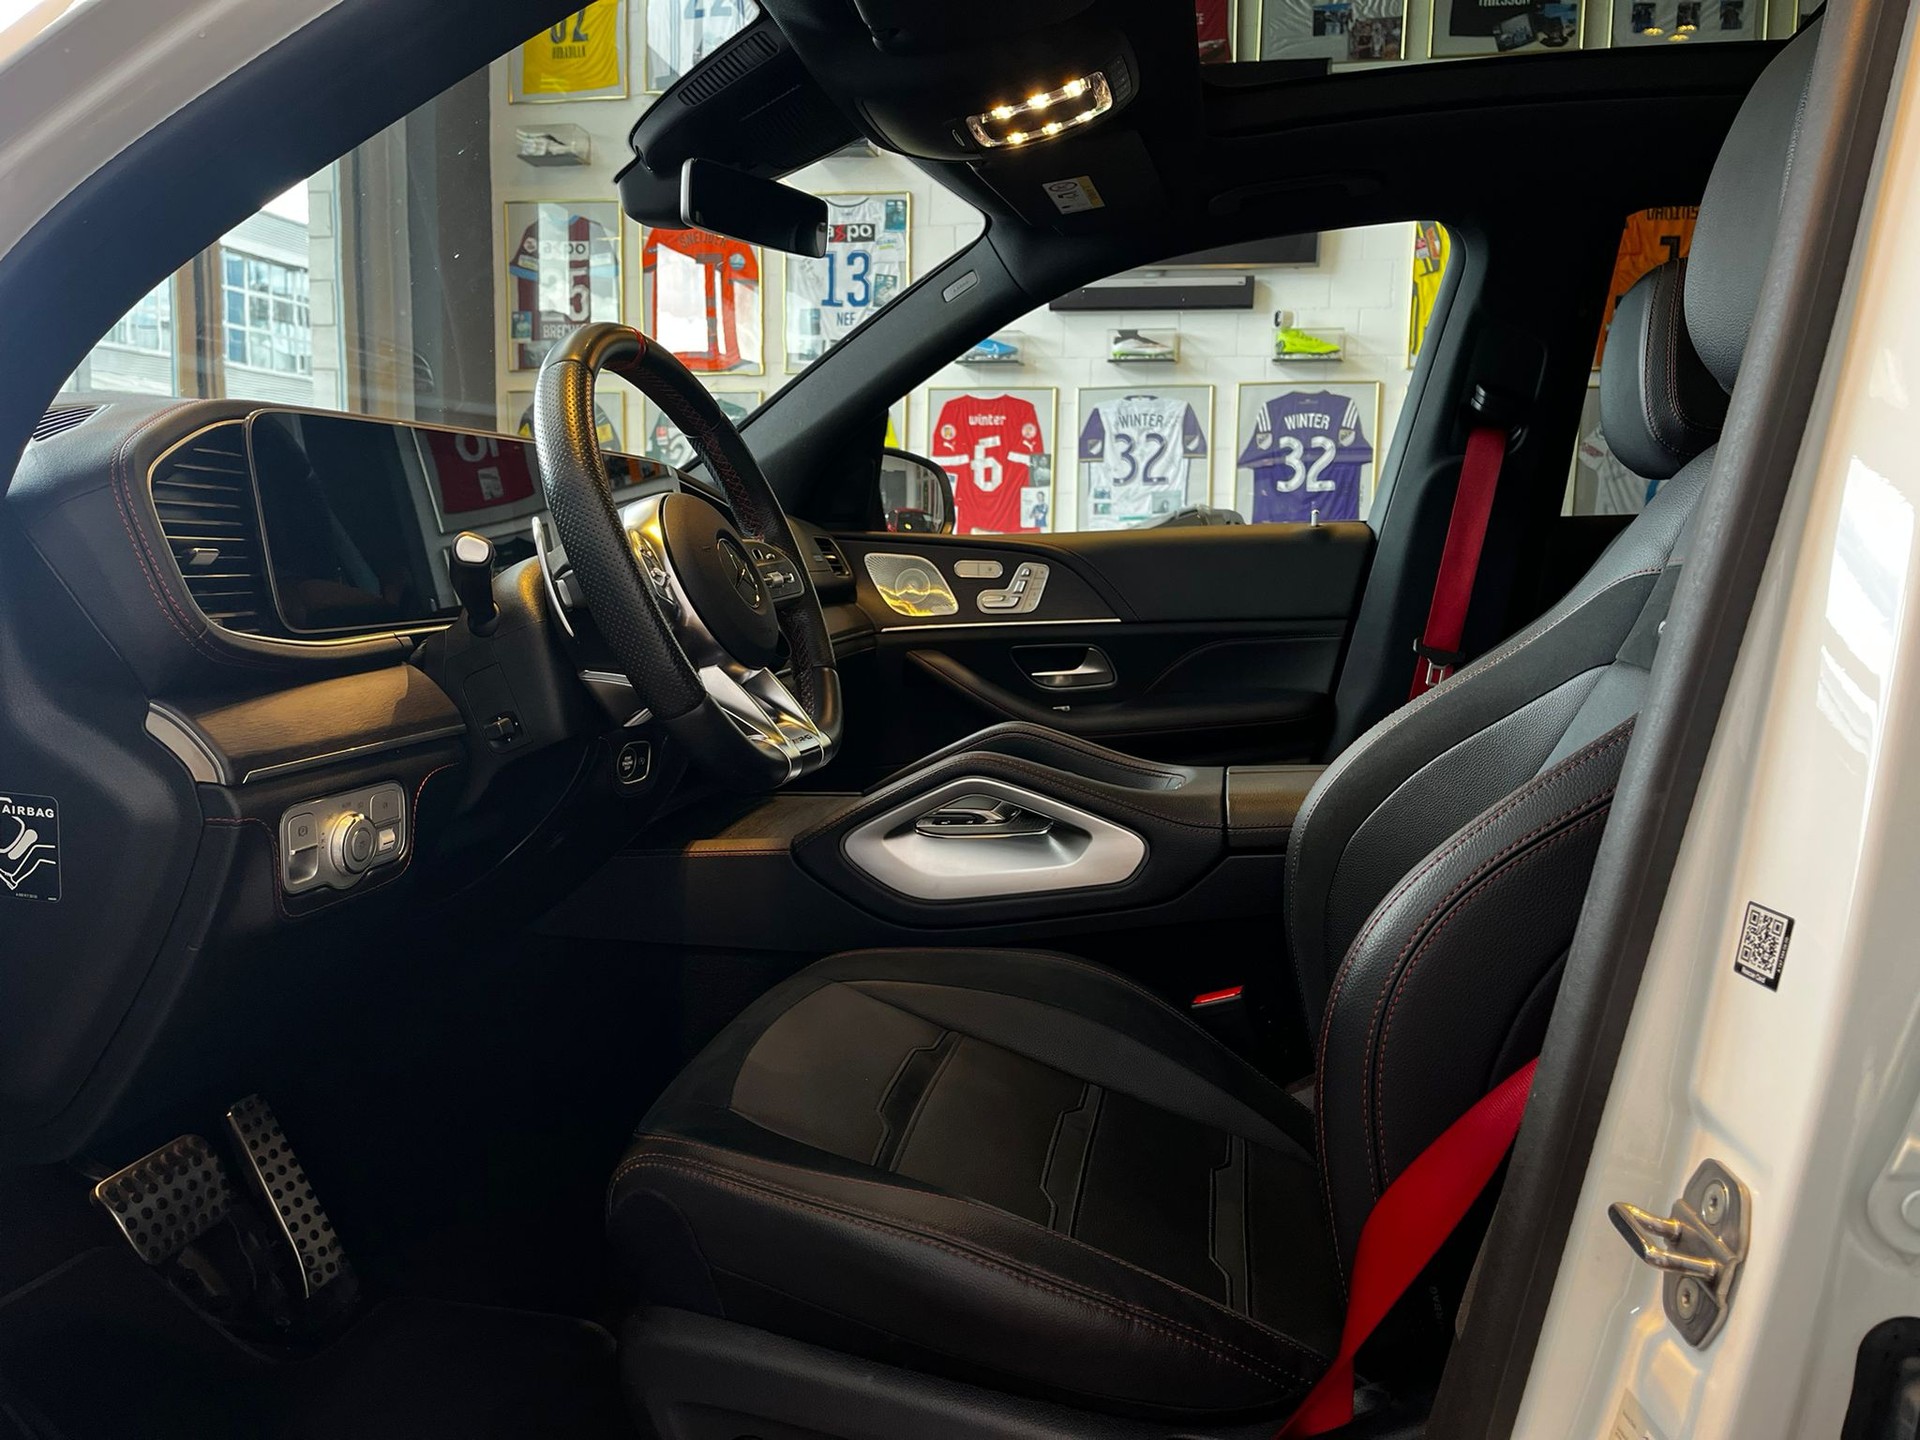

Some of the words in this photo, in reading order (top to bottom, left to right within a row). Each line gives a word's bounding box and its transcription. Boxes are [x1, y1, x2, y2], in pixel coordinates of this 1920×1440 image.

[822, 252, 870, 307] 13
[837, 313, 856, 326] NEF
[968, 413, 1007, 426] winter
[1118, 413, 1164, 429] WINTER
[1284, 412, 1330, 430] WINTER
[973, 435, 1003, 492] 6
[1113, 433, 1168, 486] 32
[1276, 435, 1336, 492] 32
[2, 804, 55, 819] AIRBAG
